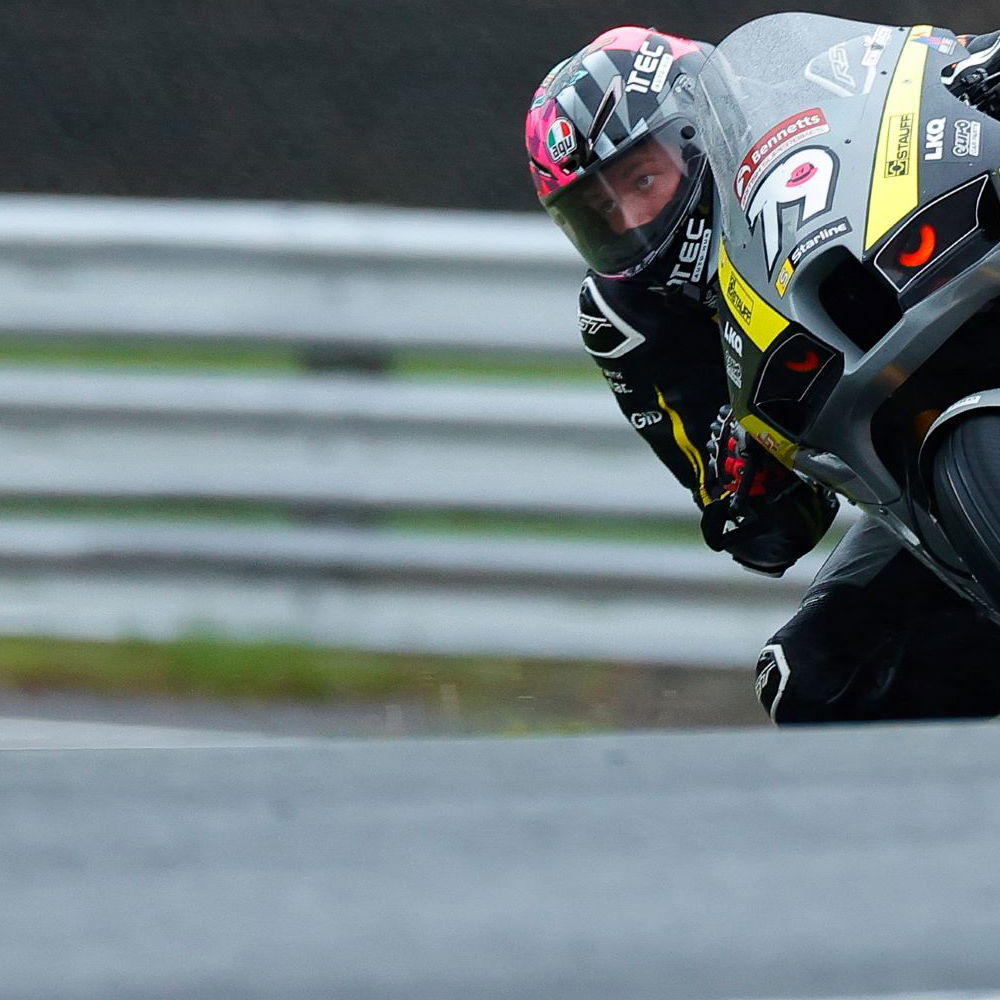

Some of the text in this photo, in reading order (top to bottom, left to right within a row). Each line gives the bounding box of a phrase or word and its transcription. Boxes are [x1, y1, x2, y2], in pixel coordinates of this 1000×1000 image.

[551, 136, 573, 160] agv
[751, 114, 821, 164] Bennetts
[897, 113, 912, 160] STAUFF
[925, 117, 947, 160] LKQ
[791, 222, 847, 261] Starline
[725, 321, 743, 357] LKQ
